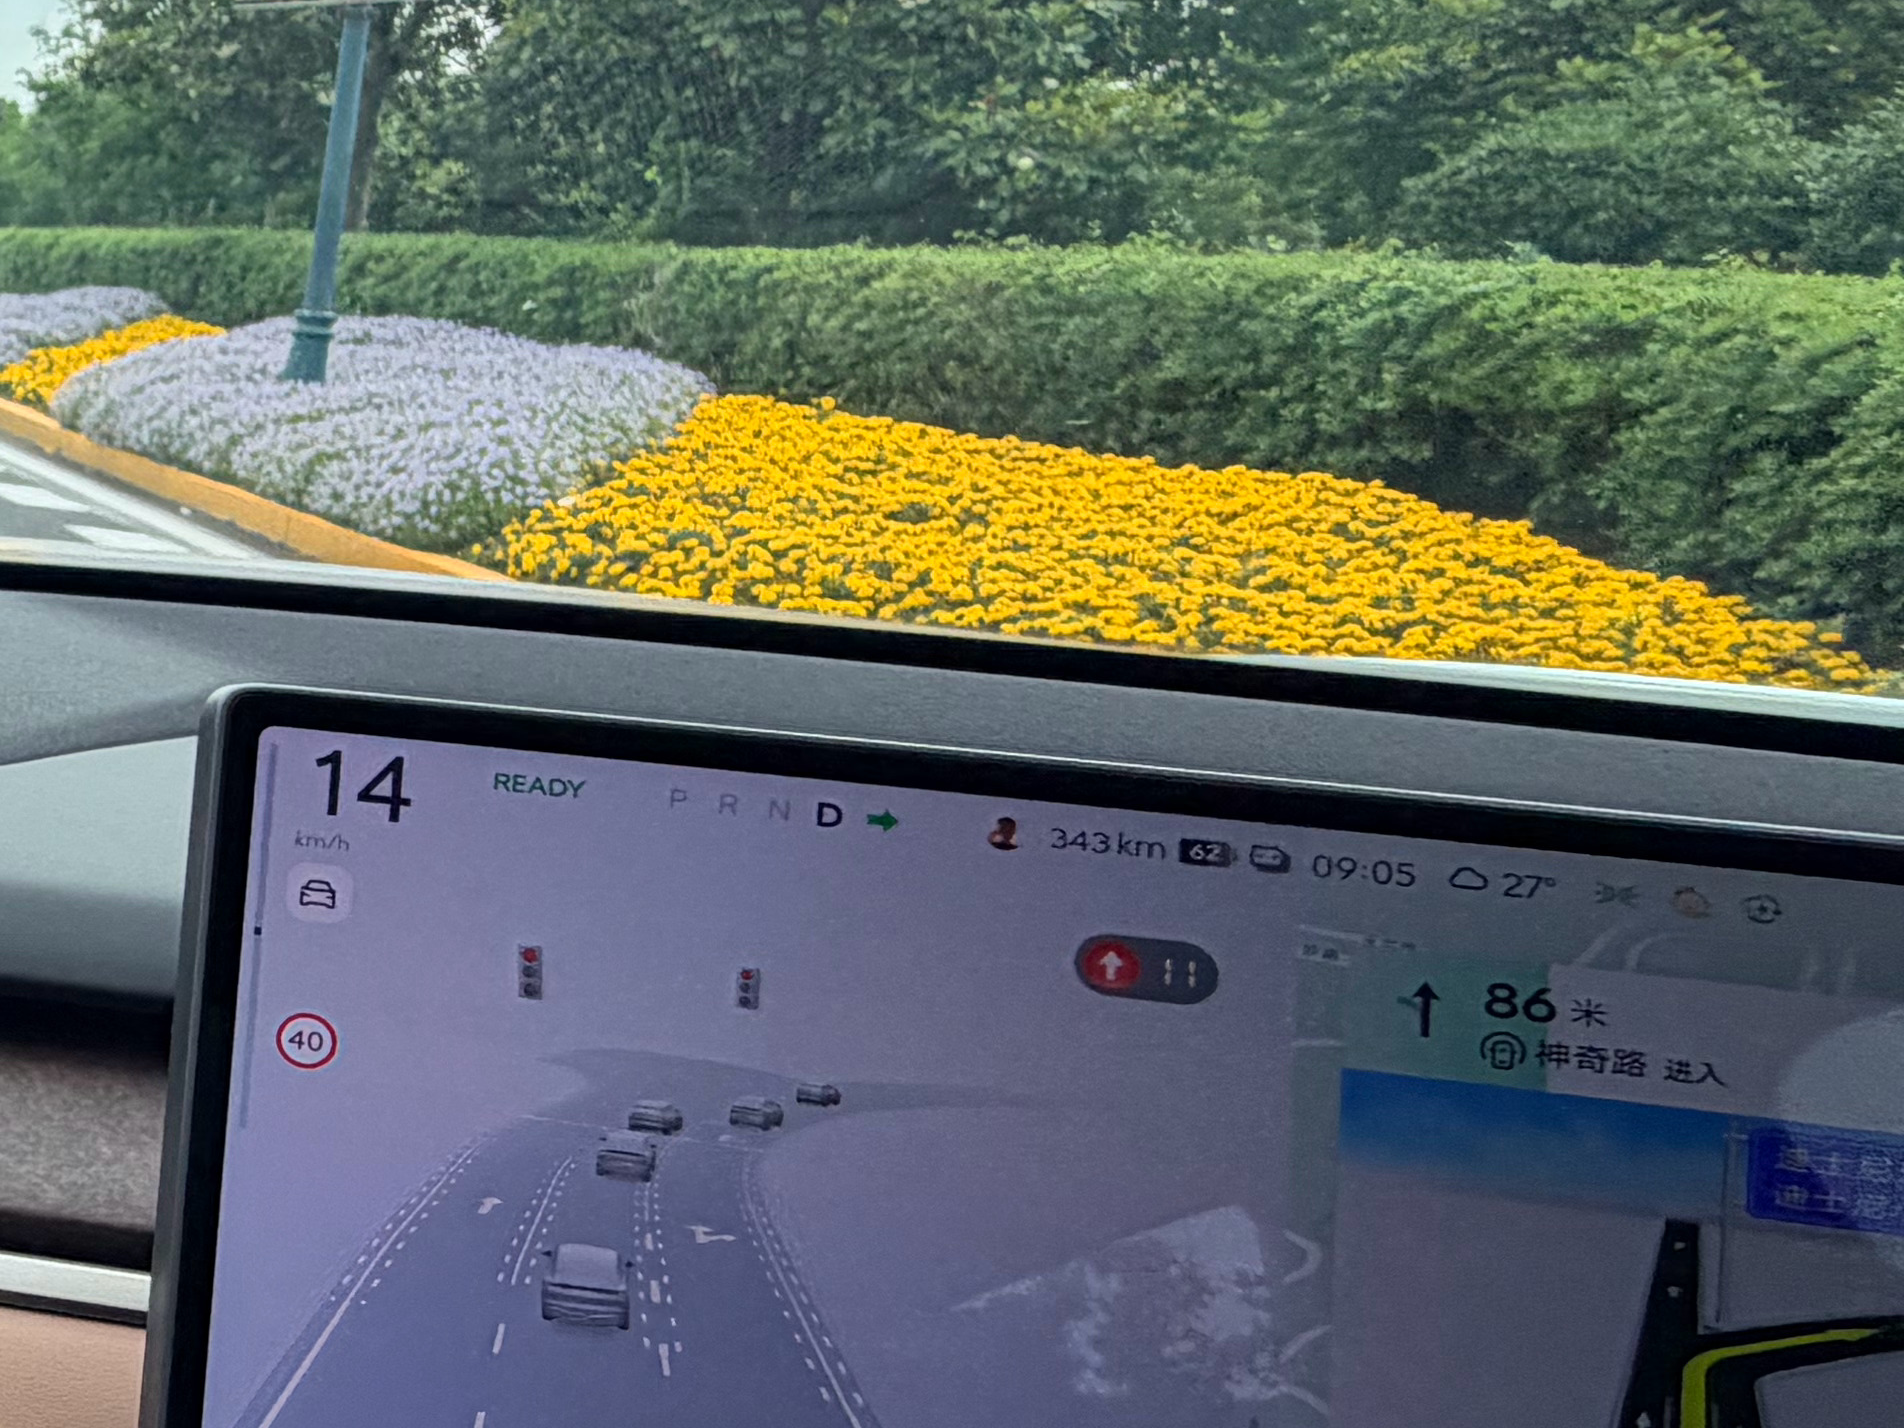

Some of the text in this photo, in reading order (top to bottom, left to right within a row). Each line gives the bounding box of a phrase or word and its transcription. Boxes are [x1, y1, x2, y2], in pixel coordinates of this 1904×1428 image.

[315, 749, 412, 823] 14
[493, 772, 587, 799] READY
[670, 788, 843, 827] P R N D
[294, 829, 350, 852] km/h
[1311, 854, 1417, 888] 09:05
[1484, 982, 1608, 1028] 86 米
[288, 1030, 324, 1052] 40
[1534, 1039, 1730, 1088] 神奇路 进入
